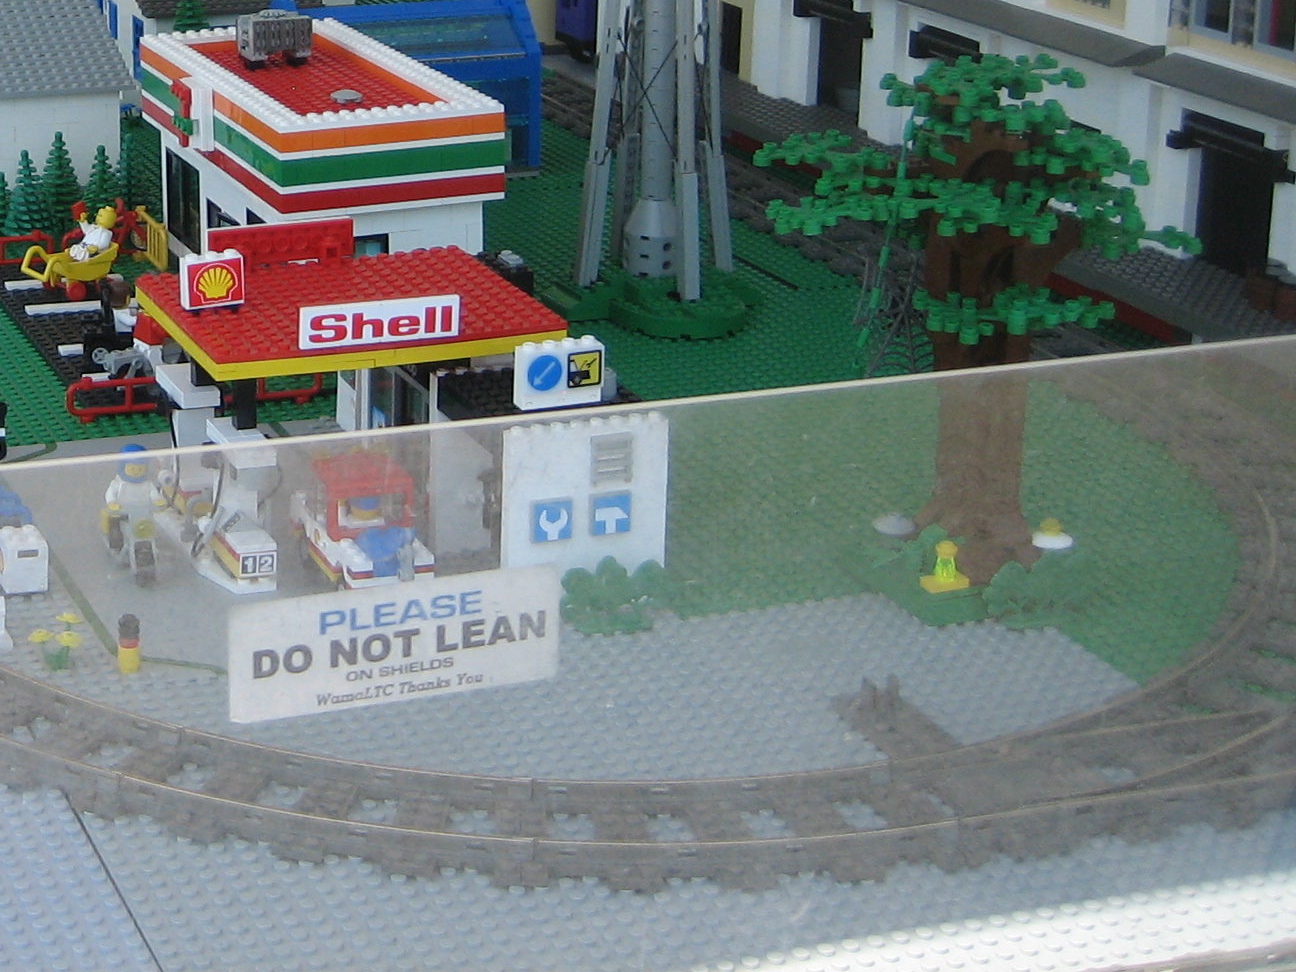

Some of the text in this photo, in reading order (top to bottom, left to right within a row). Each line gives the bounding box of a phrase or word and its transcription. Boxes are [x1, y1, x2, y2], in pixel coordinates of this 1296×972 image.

[308, 305, 453, 344] Shell
[244, 555, 273, 573] 12
[318, 590, 483, 635] PLEASE
[252, 609, 547, 680] DO NOT LEAN
[345, 657, 454, 683] ON SHIELDS
[398, 675, 451, 695] Thanks
[457, 671, 483, 686] You
